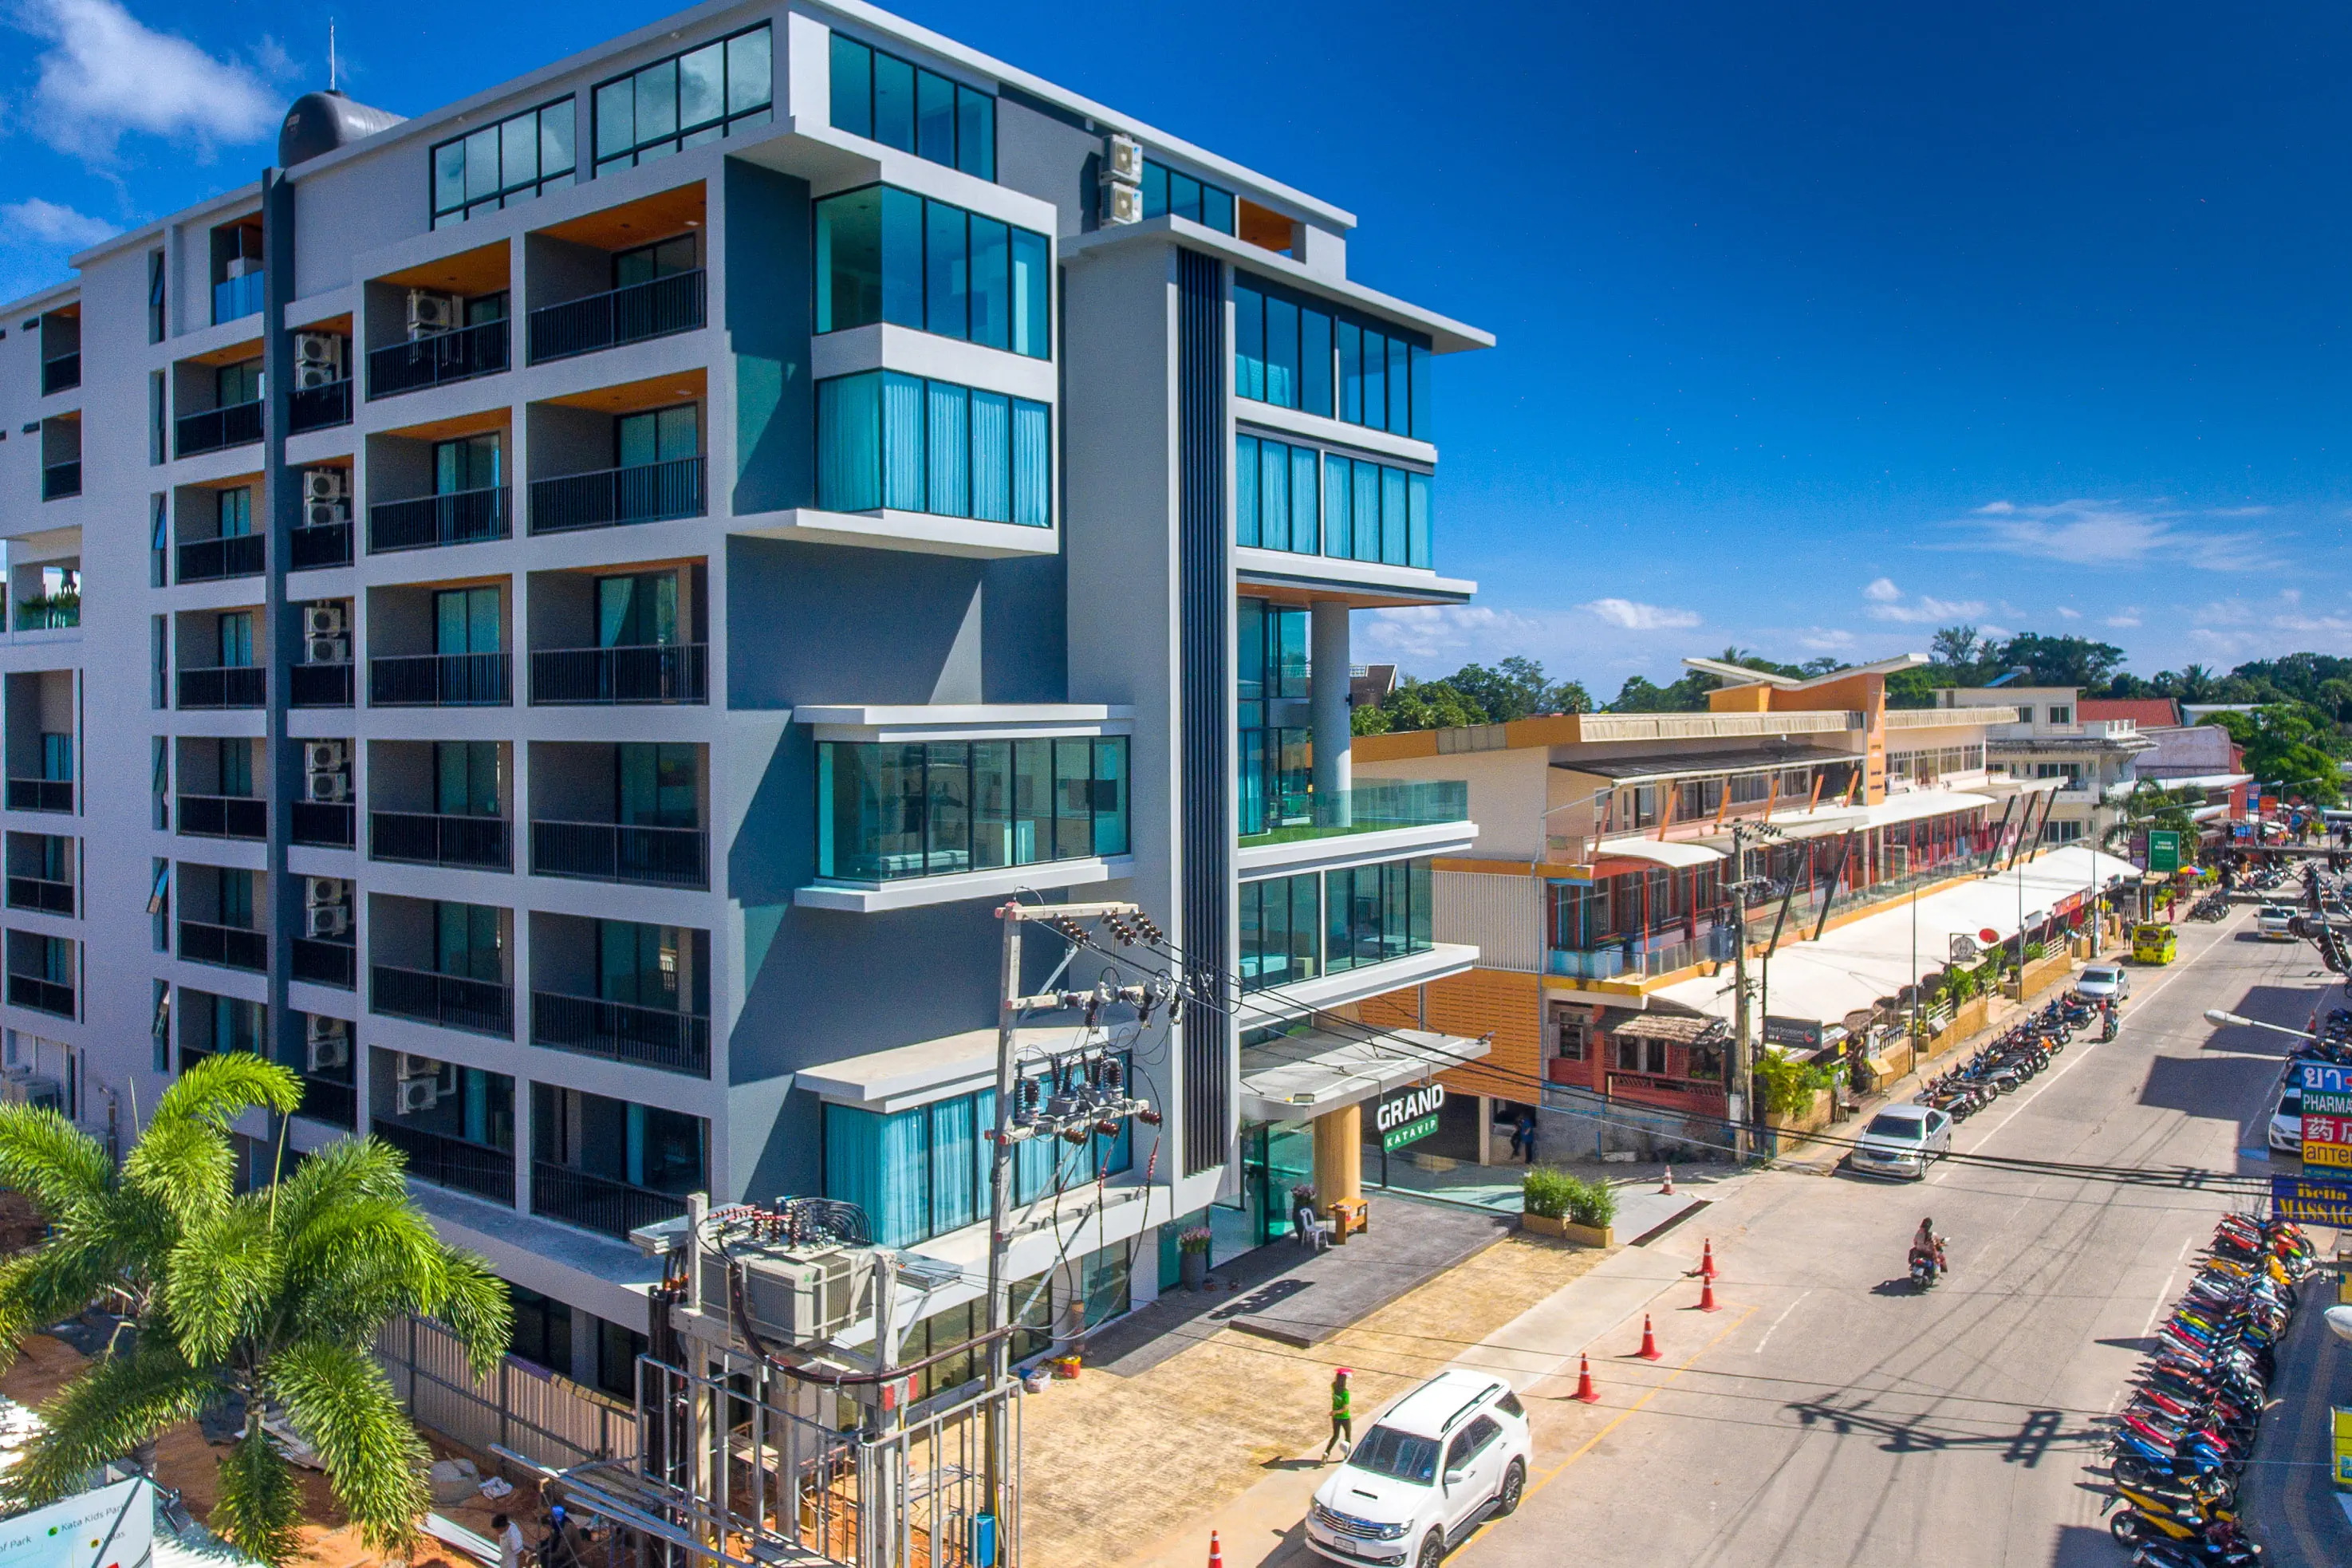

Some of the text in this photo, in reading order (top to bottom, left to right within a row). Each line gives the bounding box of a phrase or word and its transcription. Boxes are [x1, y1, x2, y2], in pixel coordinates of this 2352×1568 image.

[2303, 1067, 2342, 1090] ยา
[1377, 1083, 1444, 1131] GRAND
[1386, 1120, 1436, 1148] KATAVIP
[61, 1520, 82, 1531] Kata
[85, 1512, 104, 1523] Kids
[10, 1535, 31, 1548] Park
